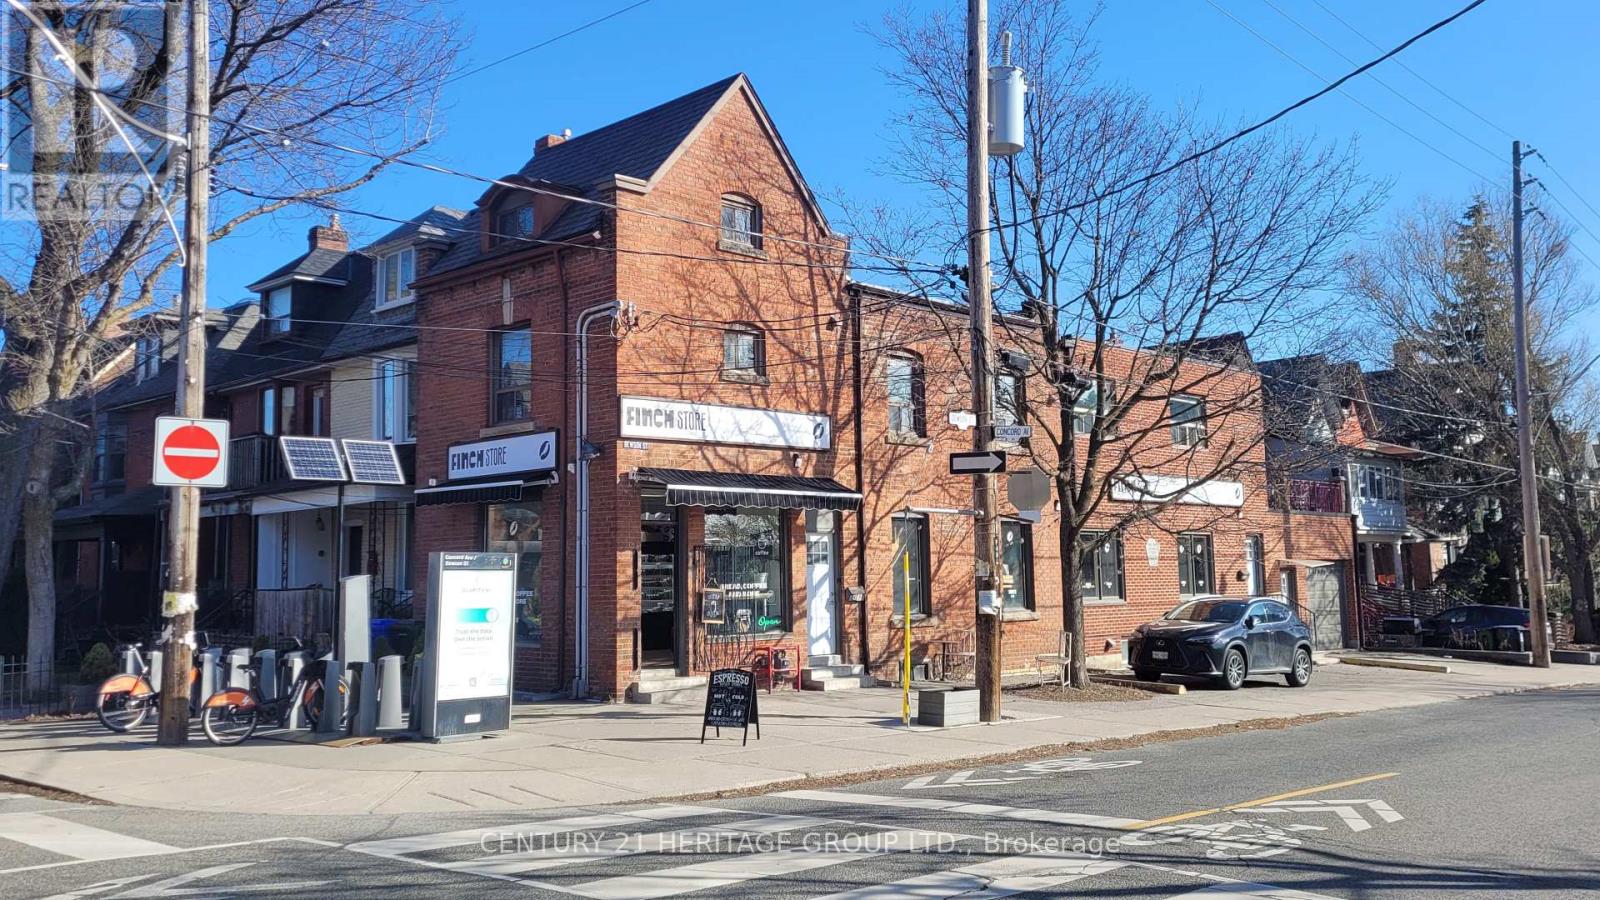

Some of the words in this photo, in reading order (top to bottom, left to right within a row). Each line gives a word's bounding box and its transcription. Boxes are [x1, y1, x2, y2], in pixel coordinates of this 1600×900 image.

[626, 406, 675, 429] FINCH
[677, 410, 706, 432] STORE
[451, 449, 484, 471] FINCH
[485, 446, 507, 467] STORE
[758, 616, 782, 629] Open
[713, 672, 750, 685] ESPRESSO
